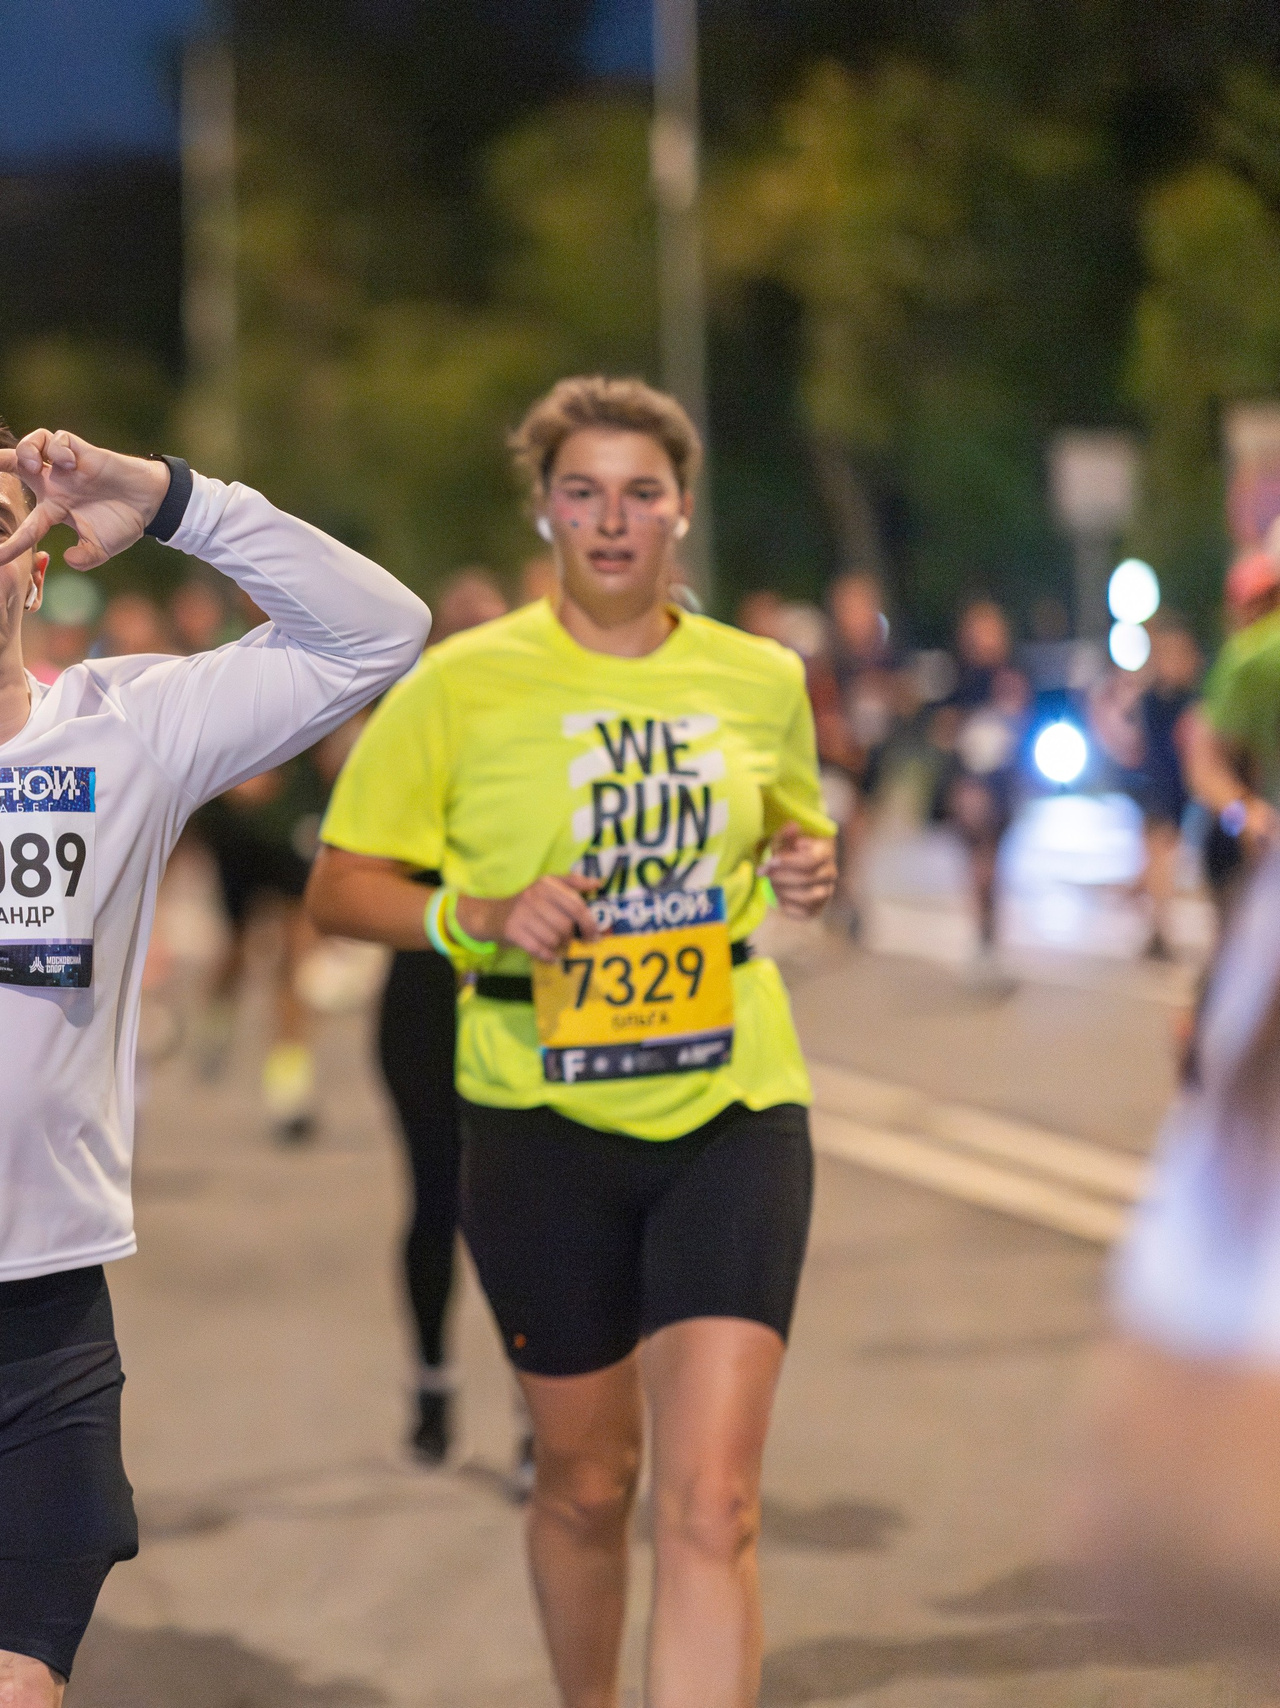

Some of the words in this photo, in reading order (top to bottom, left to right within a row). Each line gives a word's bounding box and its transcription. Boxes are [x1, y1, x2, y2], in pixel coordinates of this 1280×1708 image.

[594, 719, 700, 778] WE
[590, 781, 711, 852] RUN
[561, 945, 705, 1011] 7329
[562, 1050, 587, 1084] F
